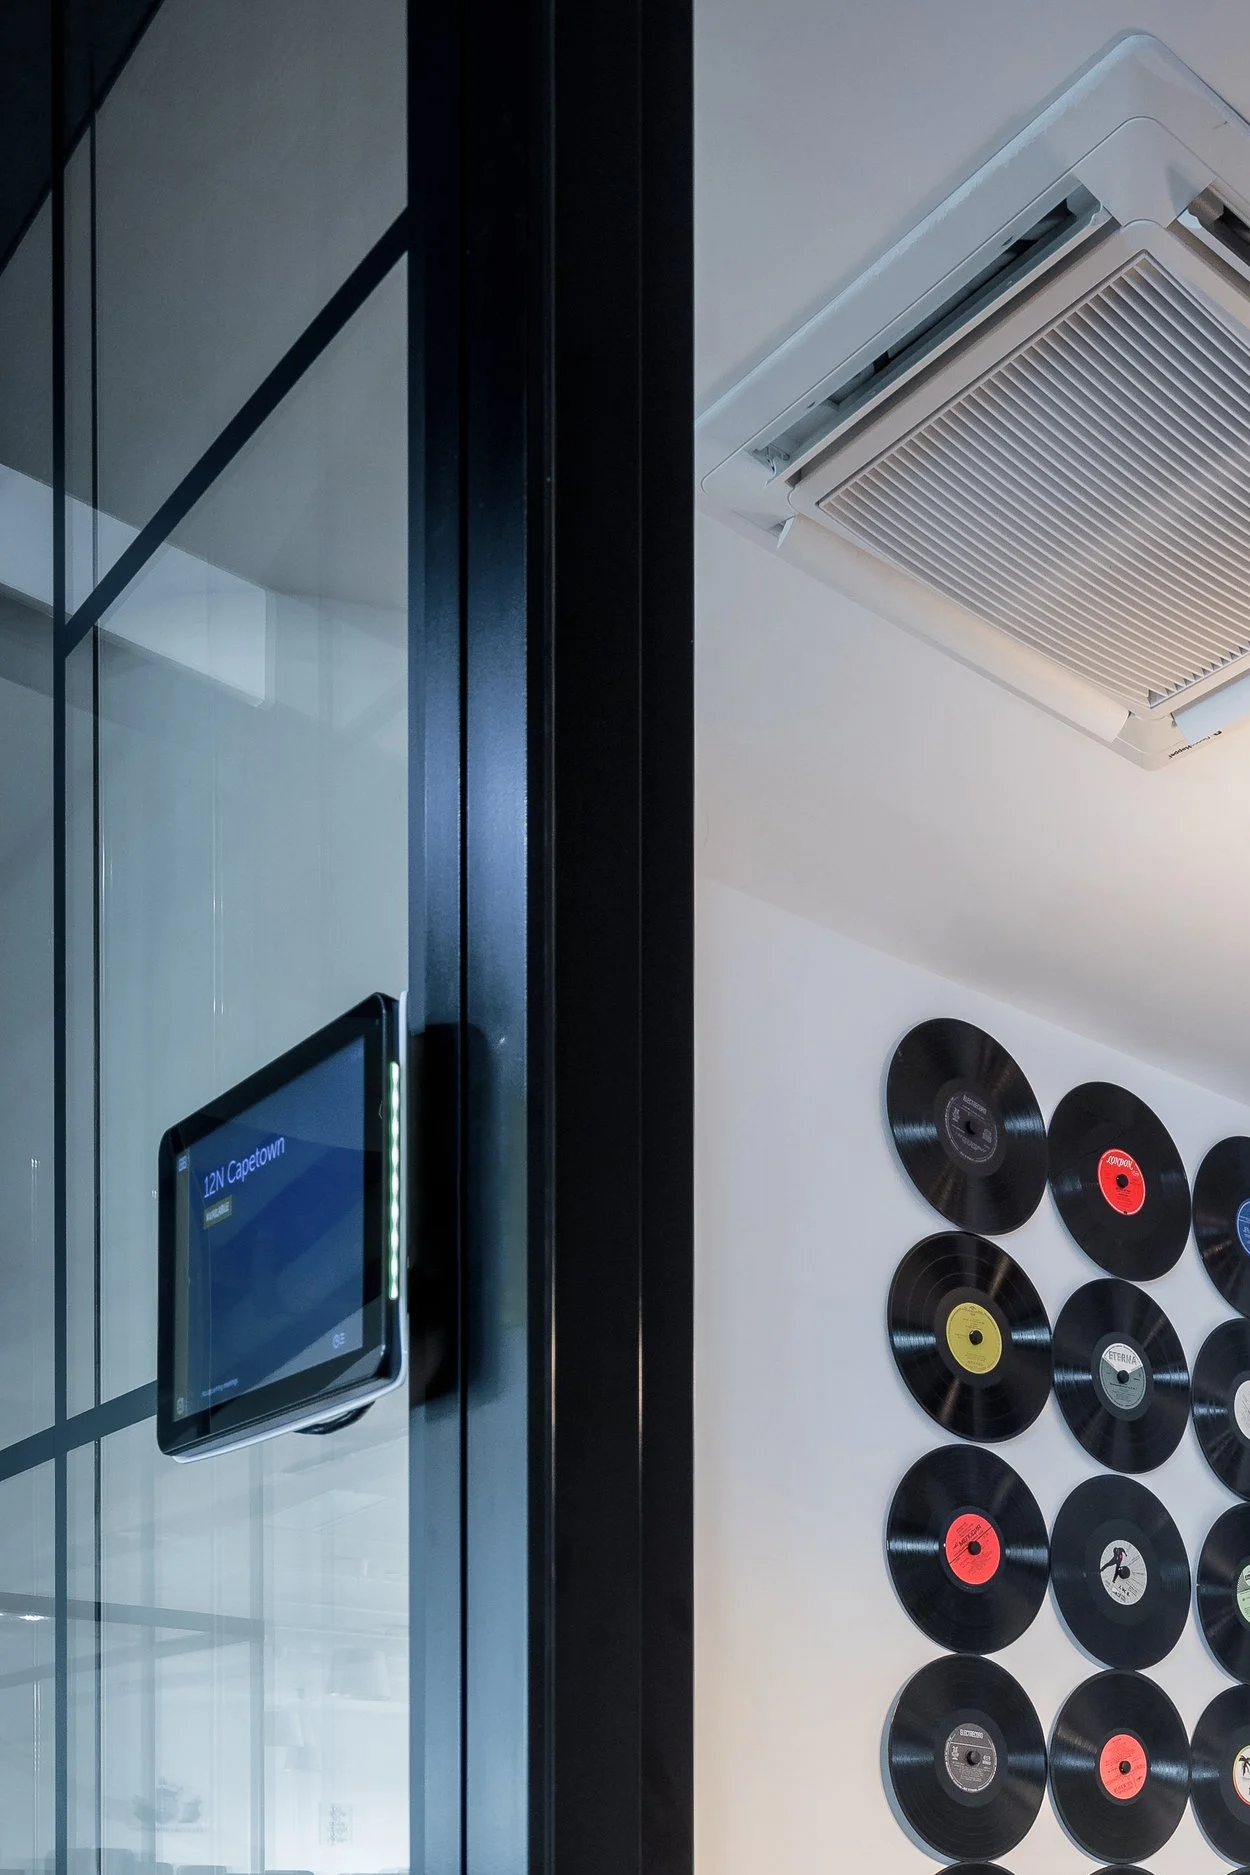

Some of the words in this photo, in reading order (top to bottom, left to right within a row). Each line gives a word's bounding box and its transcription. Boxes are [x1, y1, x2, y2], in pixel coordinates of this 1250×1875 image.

[204, 1167, 225, 1199] 12N
[227, 1136, 285, 1183] Capetown
[1106, 1155, 1134, 1171] LONDON
[1108, 1351, 1138, 1366] ETERNA
